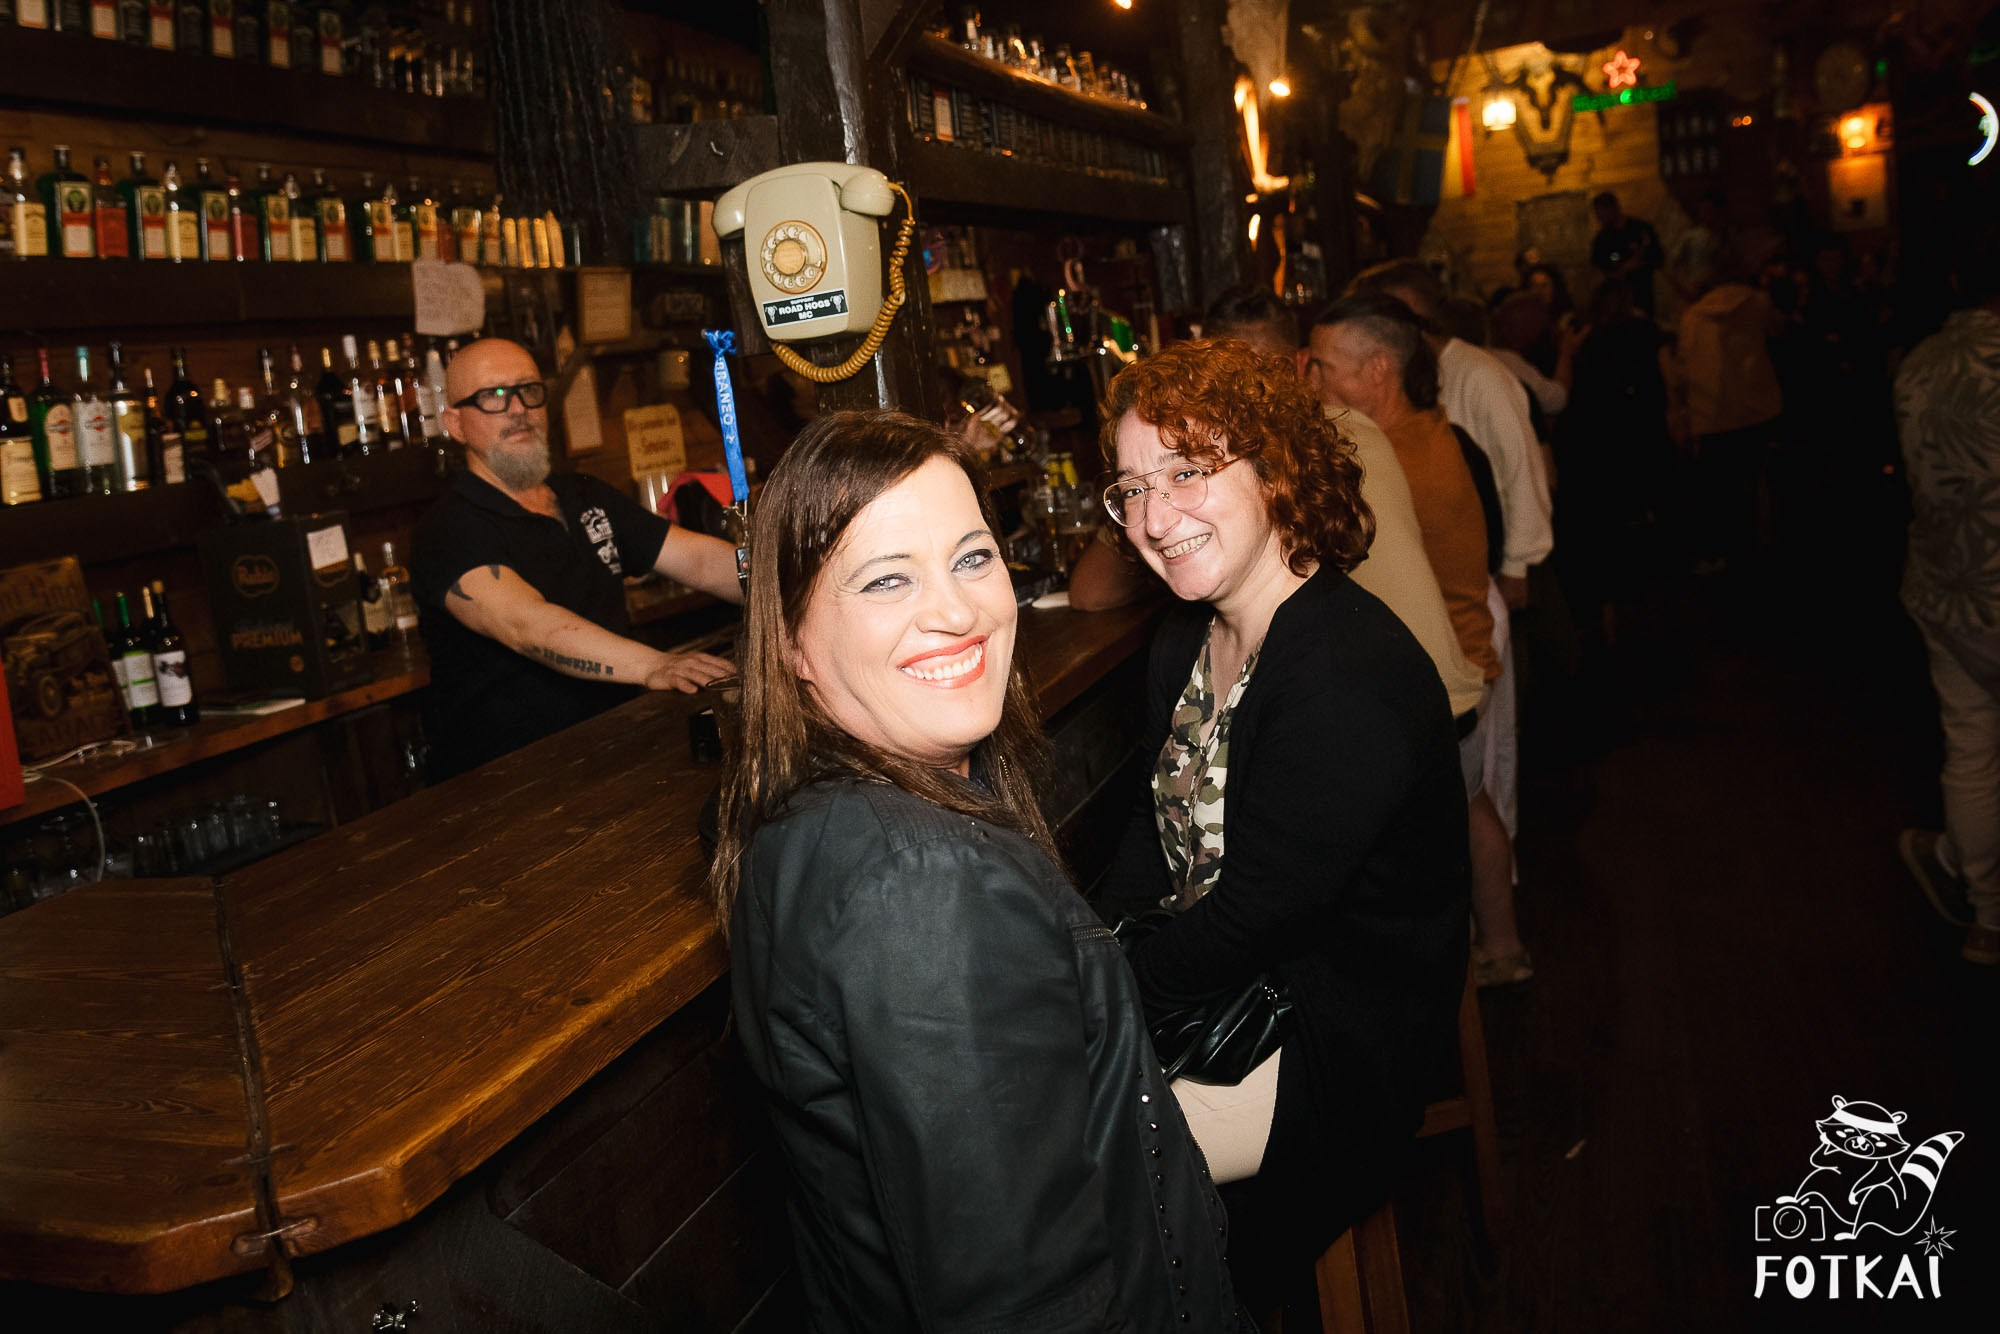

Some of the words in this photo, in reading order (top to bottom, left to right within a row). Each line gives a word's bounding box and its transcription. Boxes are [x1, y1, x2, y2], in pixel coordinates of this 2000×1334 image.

[778, 305, 804, 315] ROAD
[804, 299, 831, 311] HOGS
[798, 311, 813, 320] MC
